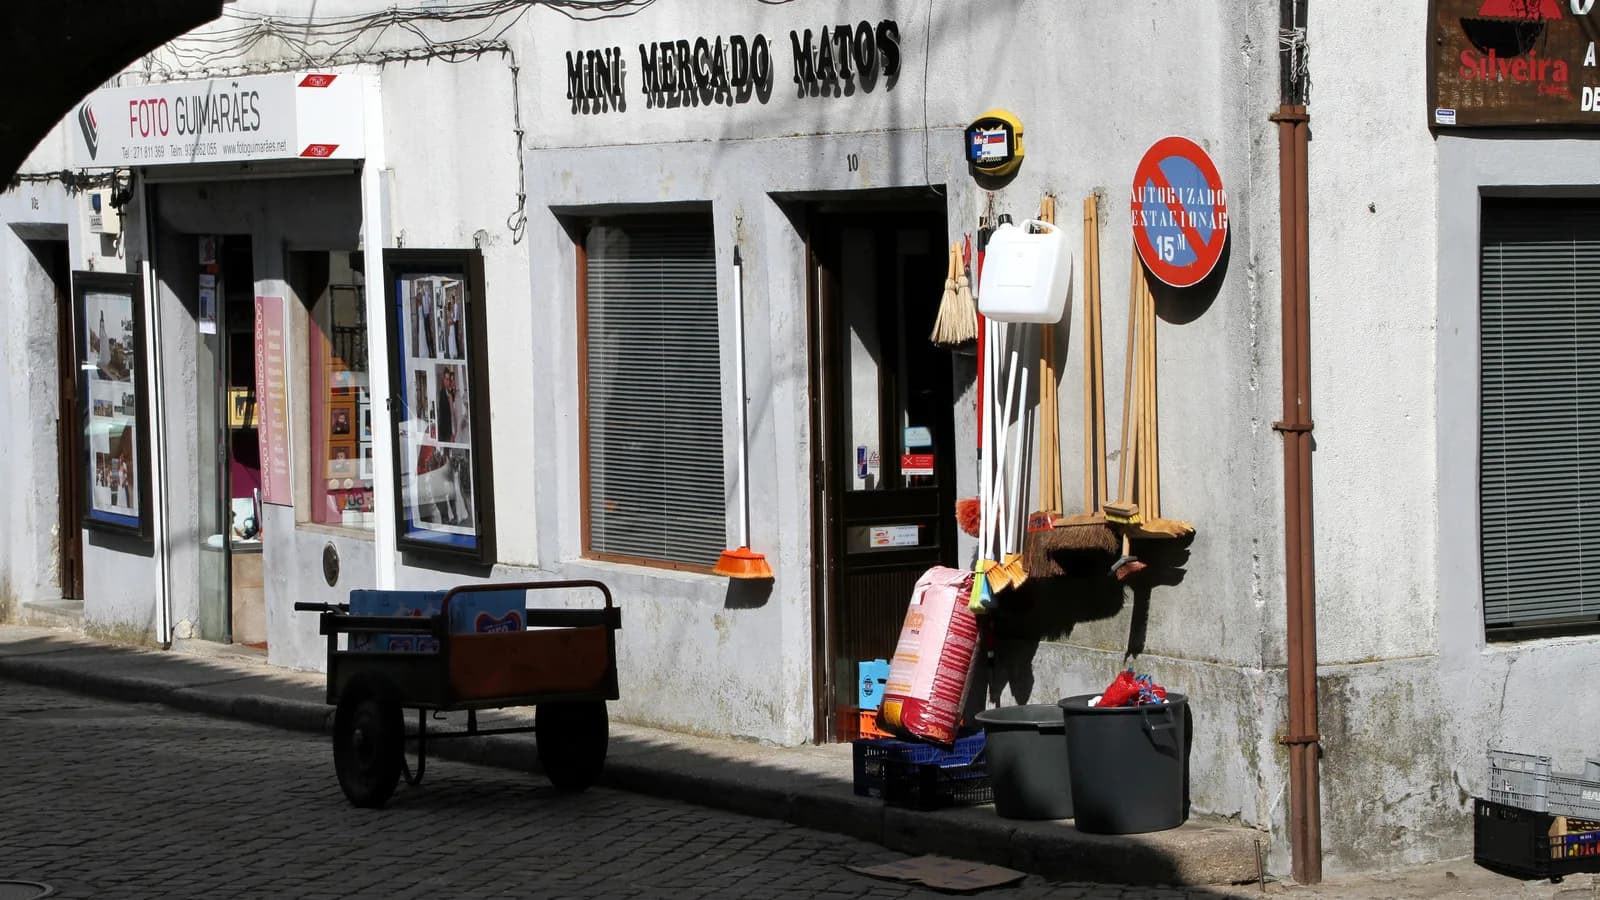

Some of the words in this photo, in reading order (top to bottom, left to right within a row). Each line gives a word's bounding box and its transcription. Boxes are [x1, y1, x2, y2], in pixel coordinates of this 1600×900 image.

[566, 46, 622, 99] MINI
[639, 33, 771, 95] MERCADO
[790, 19, 901, 84] MATOS
[1459, 48, 1569, 82] Silveira
[1583, 41, 1597, 67] A
[129, 97, 169, 138] FOTO
[175, 81, 261, 136] GUIMARÃES
[133, 146, 143, 159] 271
[847, 154, 858, 171] 10
[1130, 186, 1225, 207] AUTORIZADO
[1131, 209, 1227, 230] ESTACIONAR
[1156, 235, 1175, 262] 15
[1177, 233, 1186, 251] M
[256, 344, 268, 444] Personalizado
